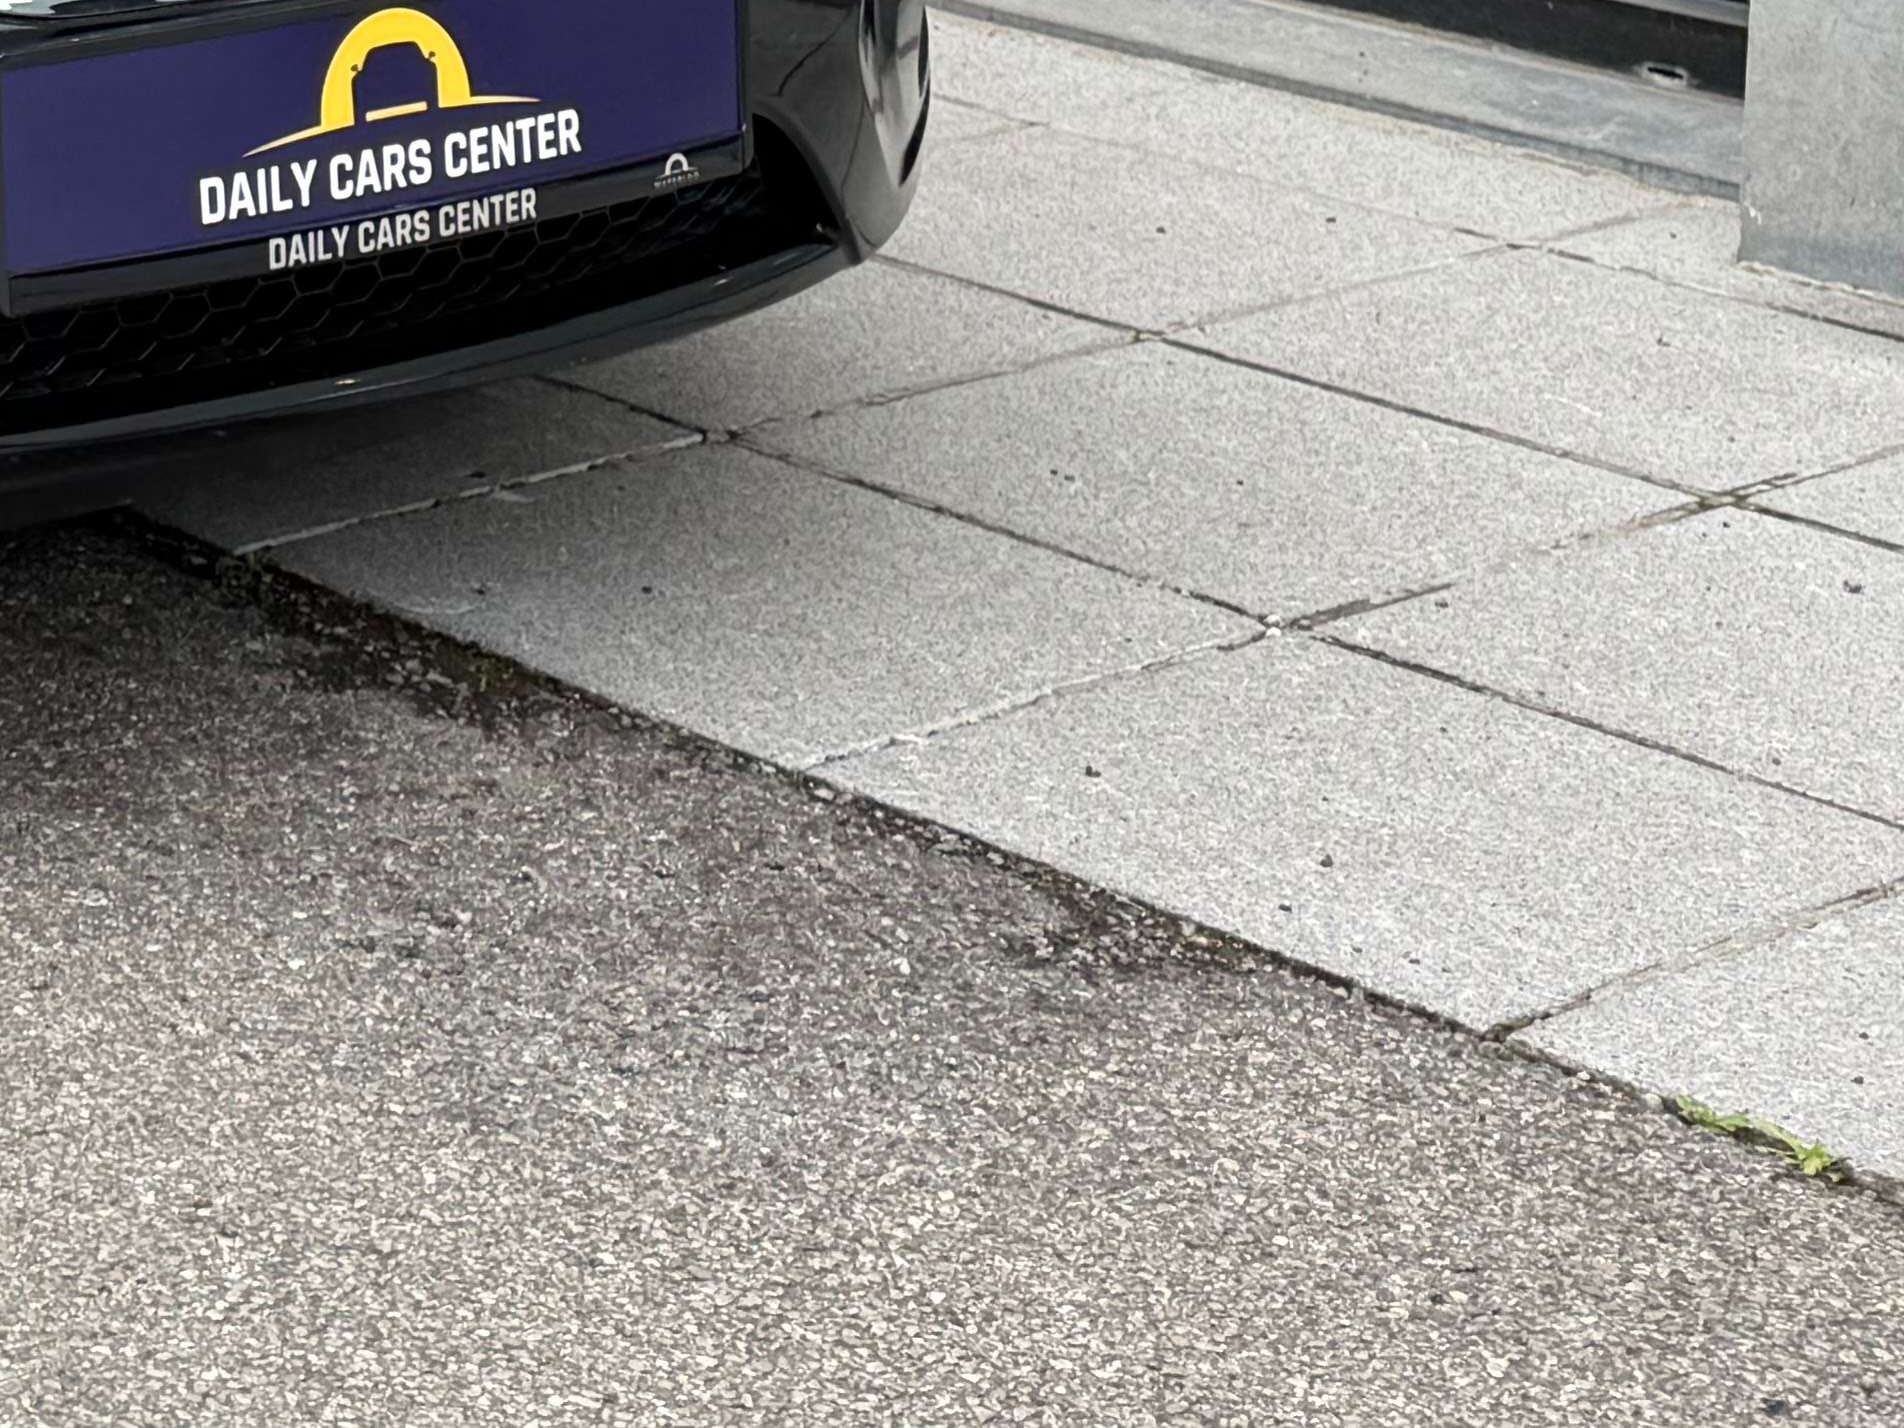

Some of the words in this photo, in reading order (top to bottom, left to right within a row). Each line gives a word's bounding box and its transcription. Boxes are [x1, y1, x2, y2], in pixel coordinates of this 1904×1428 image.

[198, 158, 318, 226] DAILY
[328, 138, 433, 201] CARS
[443, 108, 583, 179] CENTER
[267, 224, 351, 271] DAILY
[357, 209, 432, 254] CARS
[438, 187, 538, 238] CENTER
